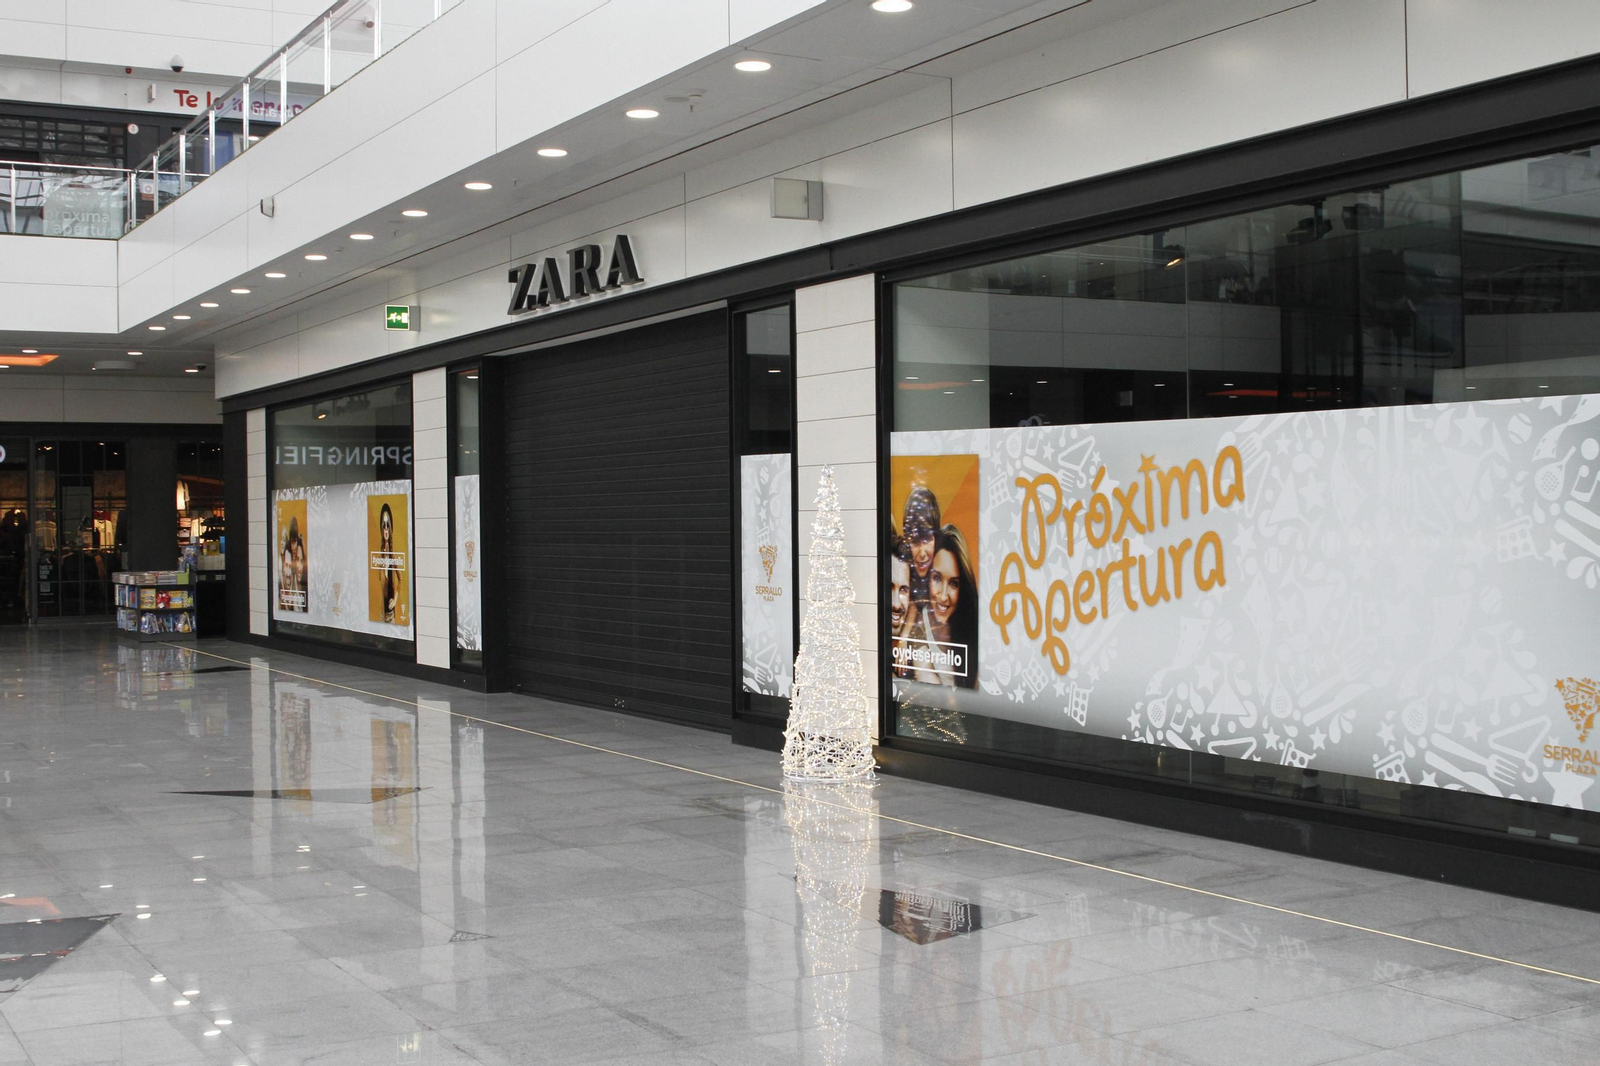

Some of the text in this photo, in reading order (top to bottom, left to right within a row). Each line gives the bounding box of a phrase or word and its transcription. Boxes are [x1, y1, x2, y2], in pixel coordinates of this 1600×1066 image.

[173, 89, 199, 108] Te
[507, 234, 645, 315] ZARA
[1015, 445, 1245, 569] Próxima
[755, 585, 783, 596] SERRALLO
[989, 531, 1226, 676] Apertura
[892, 645, 962, 667] oydeserrallo
[1565, 763, 1598, 776] PLAZA
